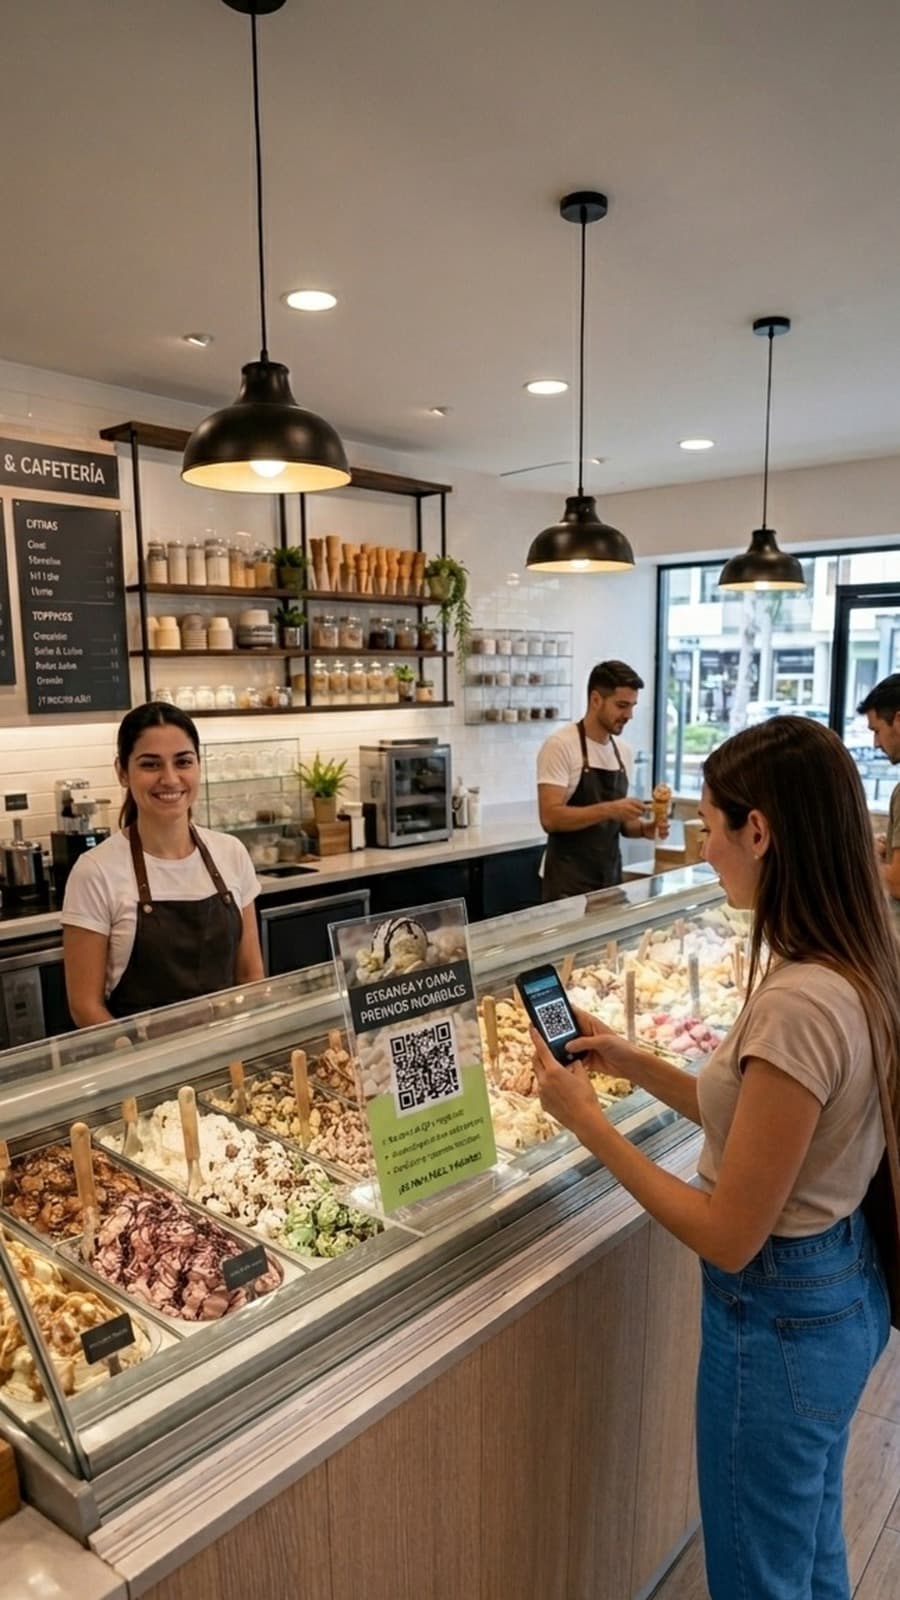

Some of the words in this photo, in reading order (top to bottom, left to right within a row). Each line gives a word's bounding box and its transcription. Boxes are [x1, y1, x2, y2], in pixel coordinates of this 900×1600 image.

[4, 453, 17, 473] &
[20, 456, 106, 485] CAFETERÍA
[416, 979, 425, 991] Y
